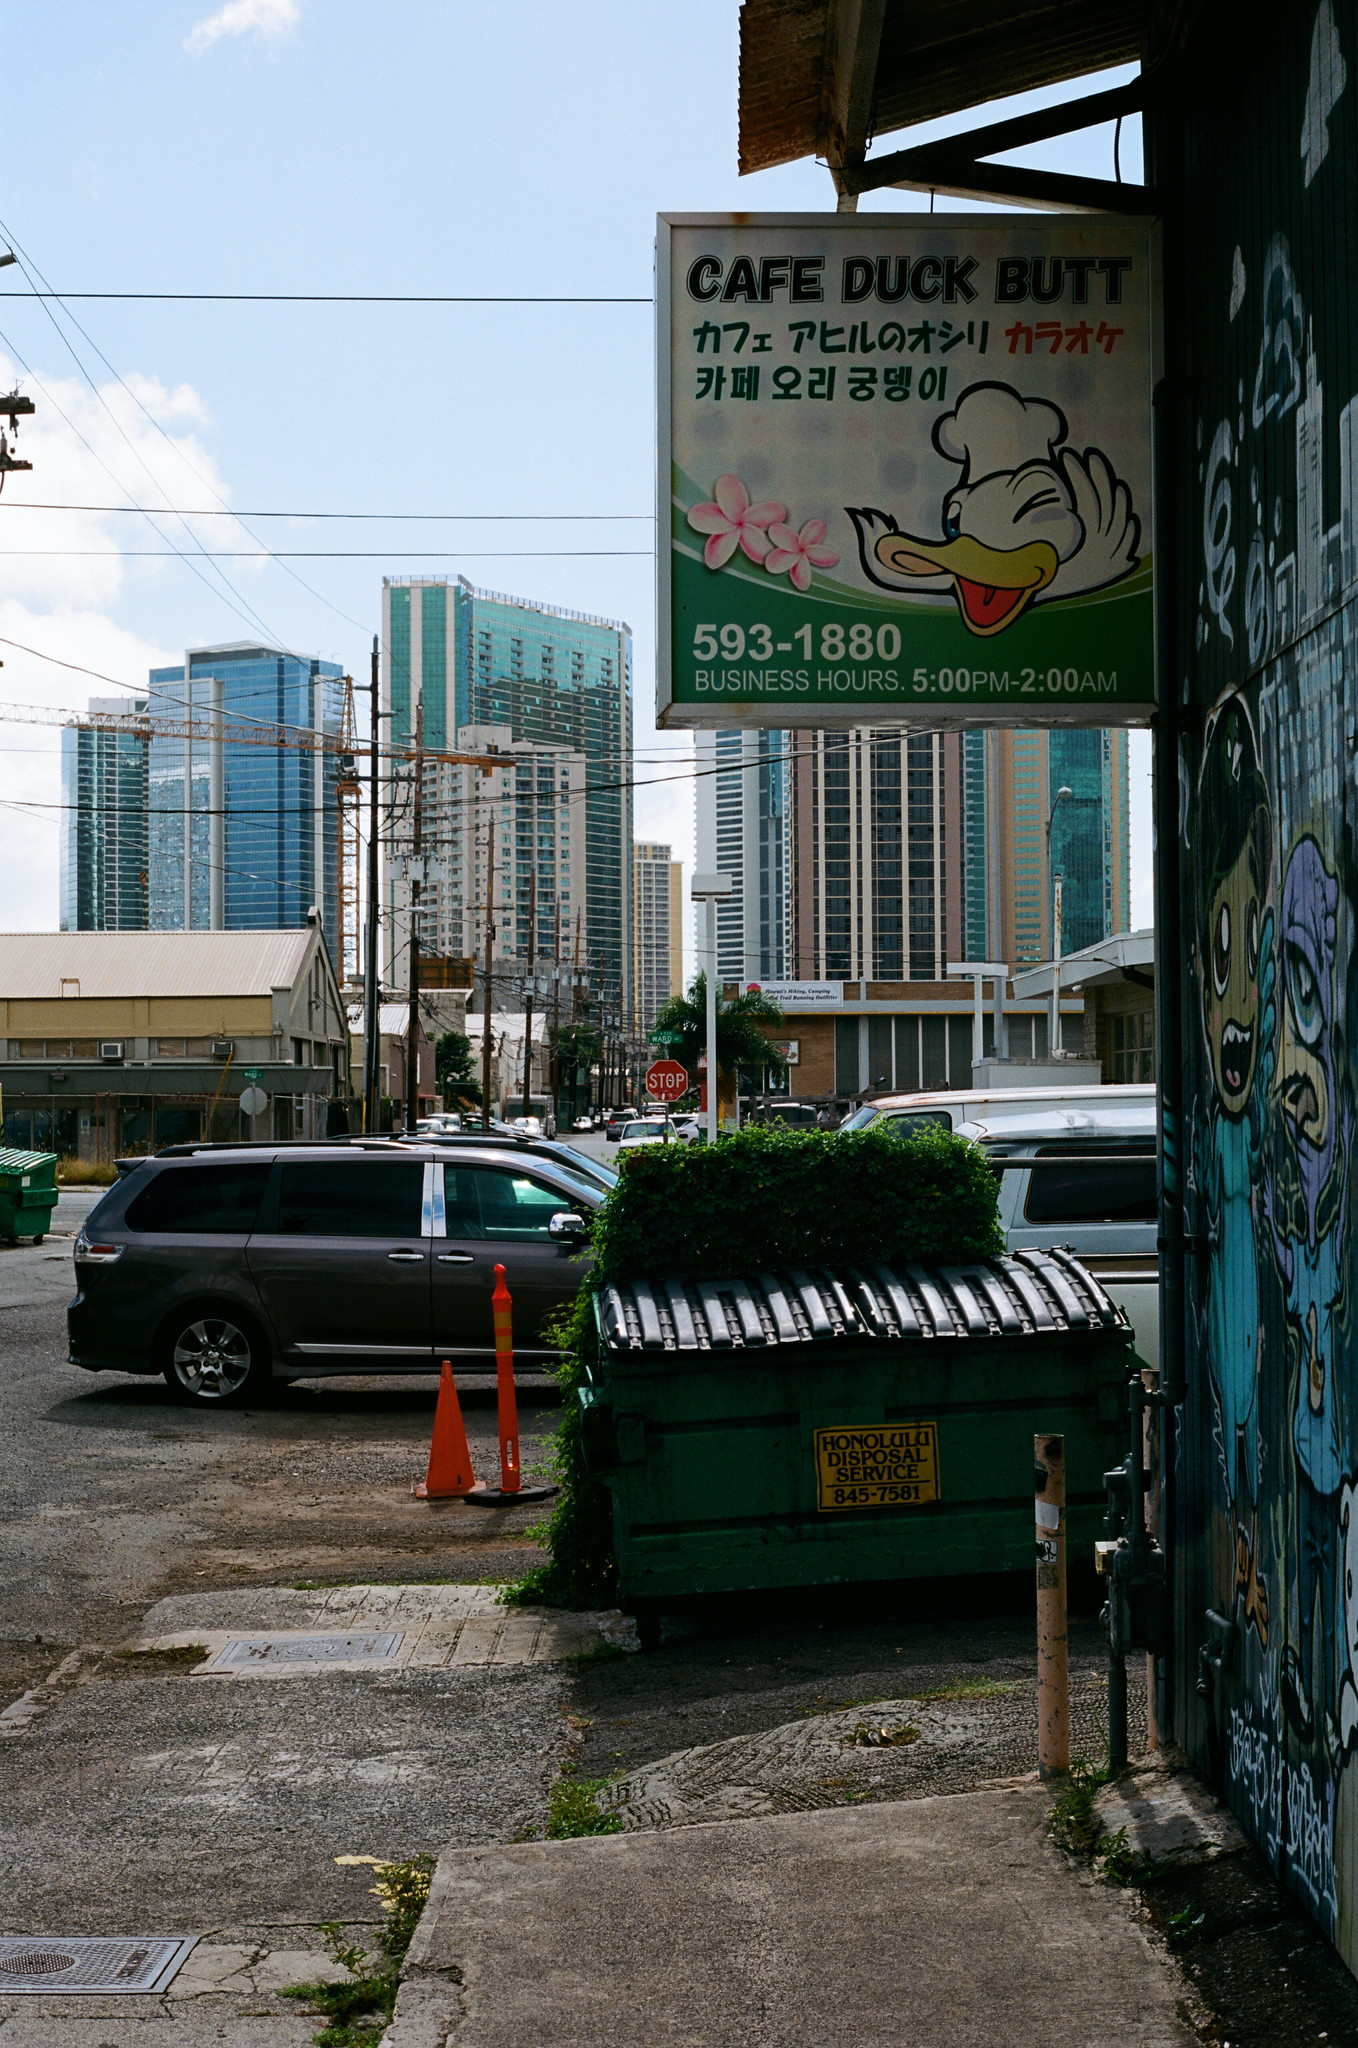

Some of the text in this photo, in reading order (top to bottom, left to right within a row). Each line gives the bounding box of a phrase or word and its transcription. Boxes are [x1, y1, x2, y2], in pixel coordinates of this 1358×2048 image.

[686, 254, 1132, 305] CAFE DUCK BUTT
[693, 319, 1125, 355] カフェ アヒルのオシリ カラオケ
[695, 365, 948, 402] 카페 오리 궁뎅이
[693, 623, 901, 662] 593-1880
[695, 670, 809, 692] BUSINESS
[912, 667, 1117, 693] 5:00PM-2:00AM
[651, 1035, 672, 1043] WARD
[649, 1073, 685, 1088] STOP
[821, 1431, 930, 1451] HONOLULU
[827, 1448, 928, 1467] DISPOSAL
[836, 1464, 919, 1483] SERVICE
[834, 1485, 921, 1505] 845-7581
